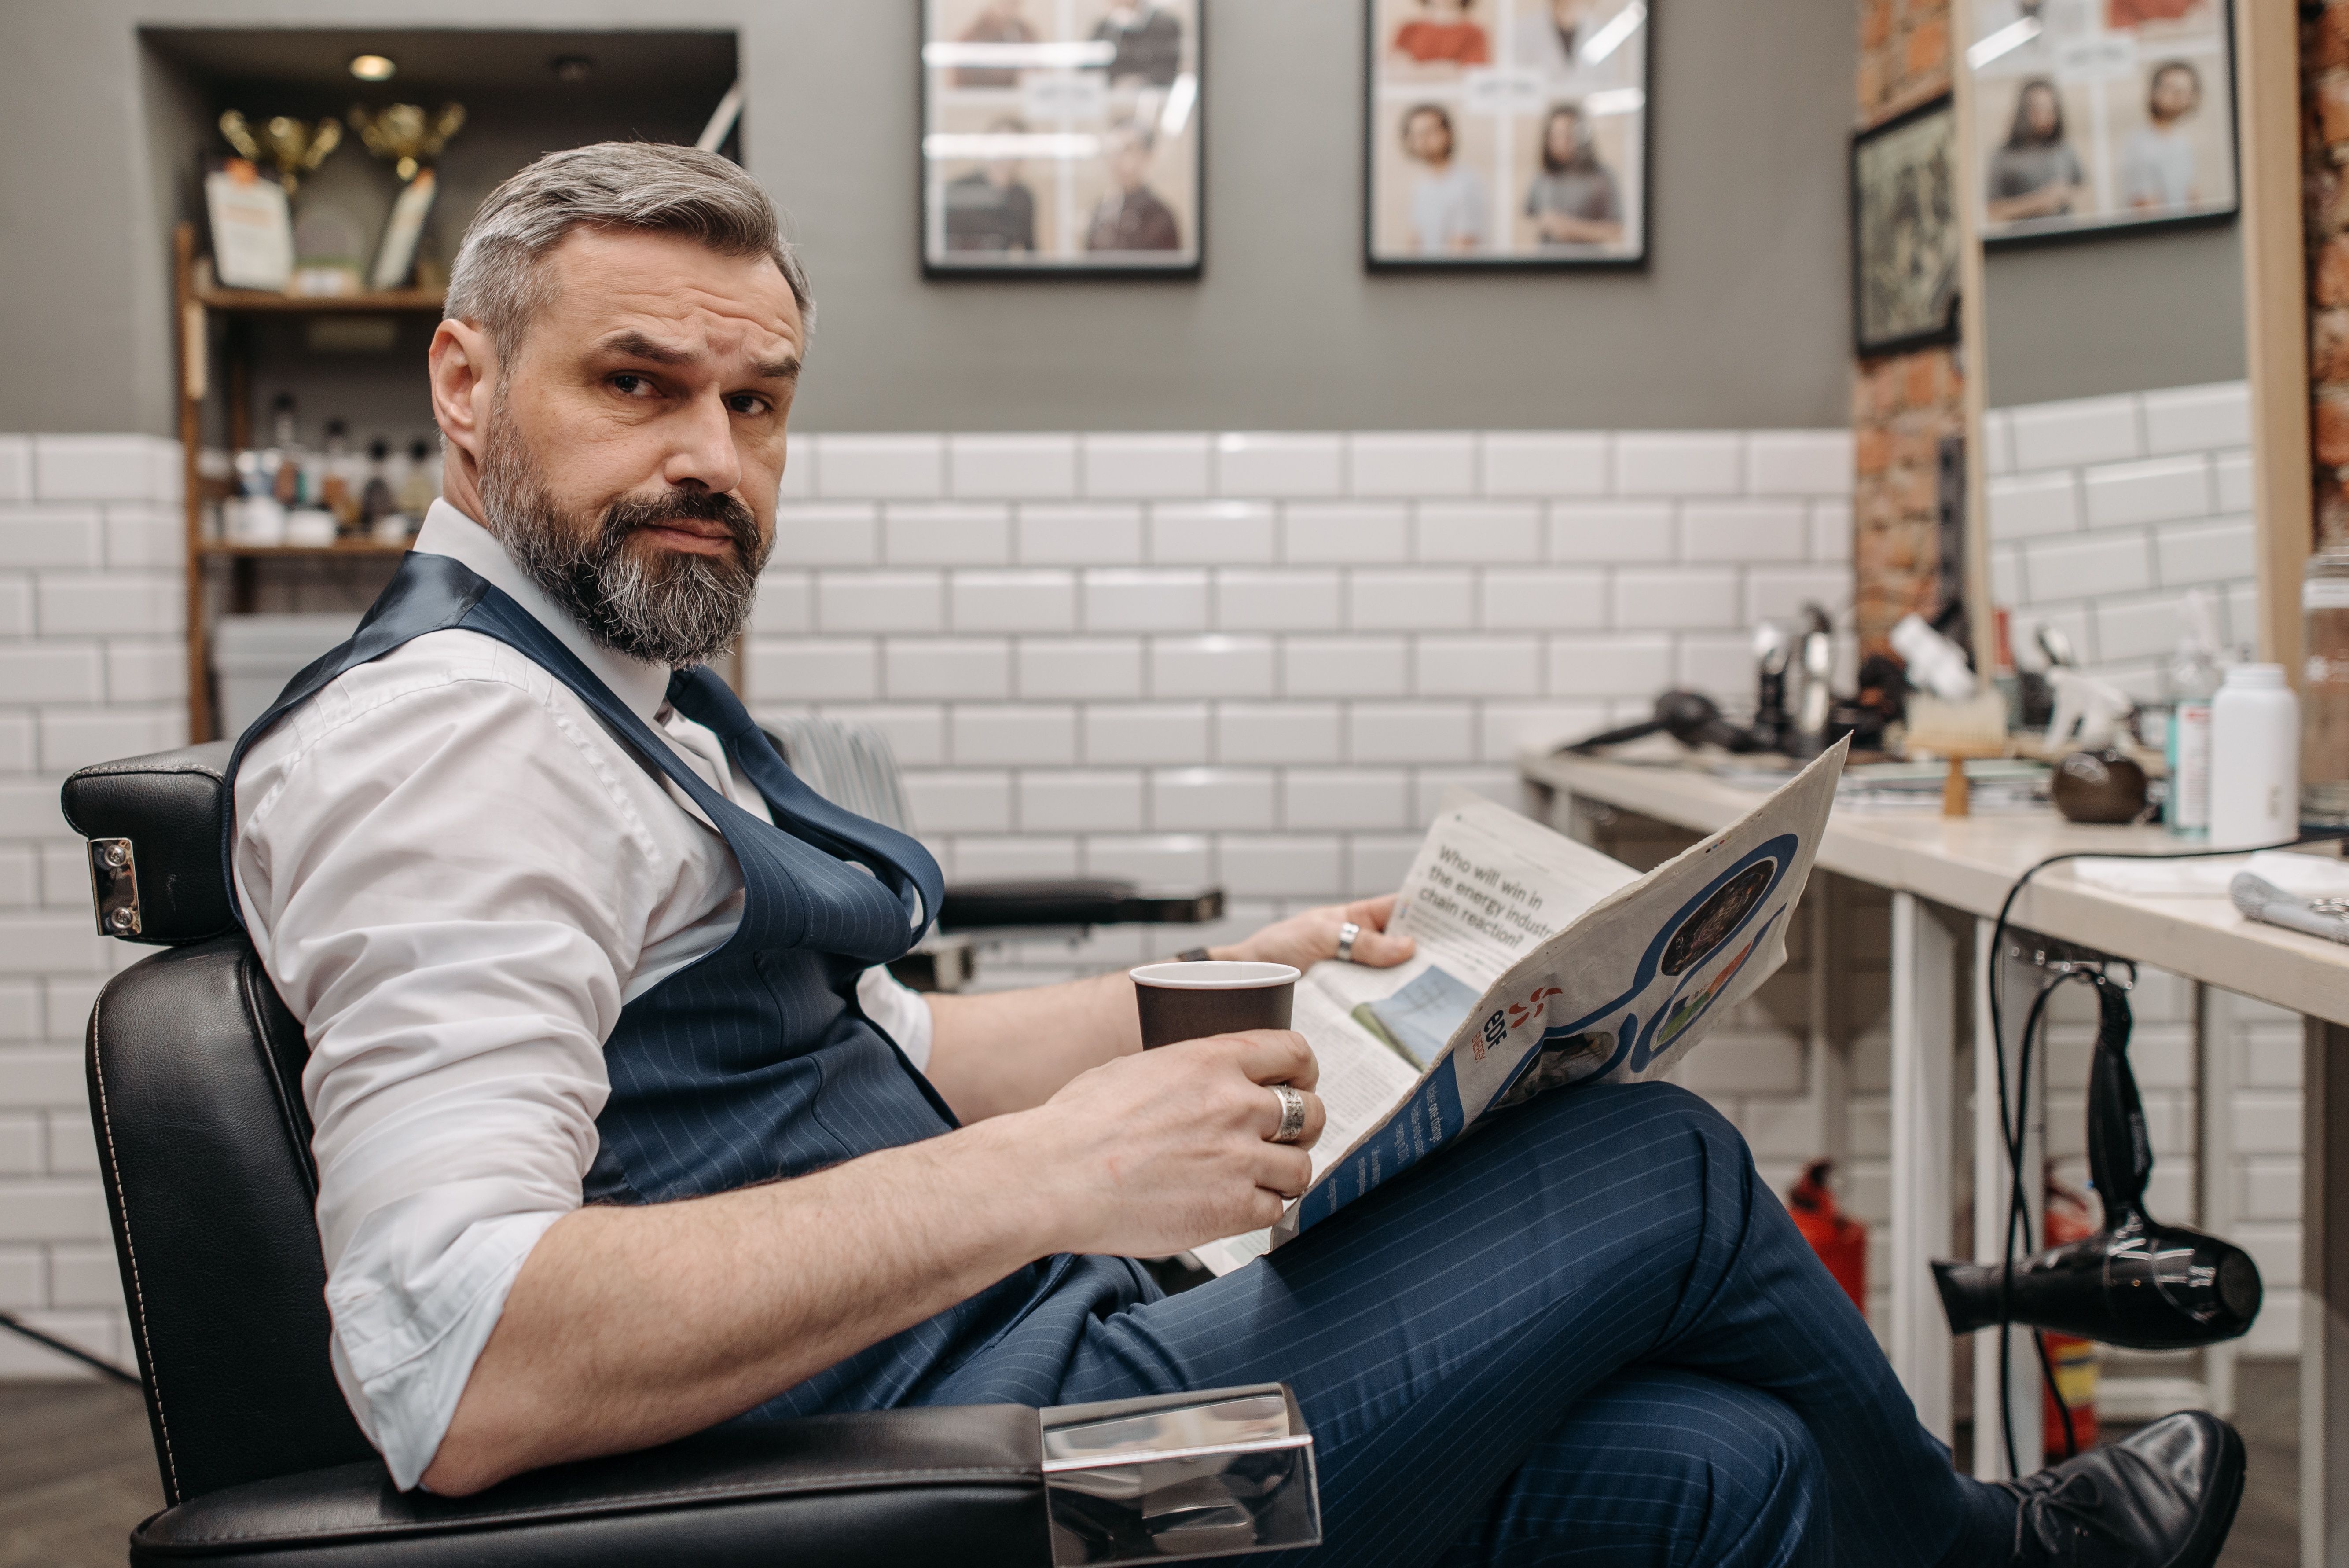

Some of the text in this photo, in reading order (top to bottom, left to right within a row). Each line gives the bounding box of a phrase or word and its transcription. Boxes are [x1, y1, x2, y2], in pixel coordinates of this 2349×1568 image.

[1429, 866, 1557, 939] the energy industr
[1439, 845, 1542, 910] Who will win in
[1419, 887, 1459, 916] chain
[1461, 908, 1524, 949] reaction?
[1472, 1030, 1486, 1064] ENERGY
[1428, 1103, 1439, 1120] one
